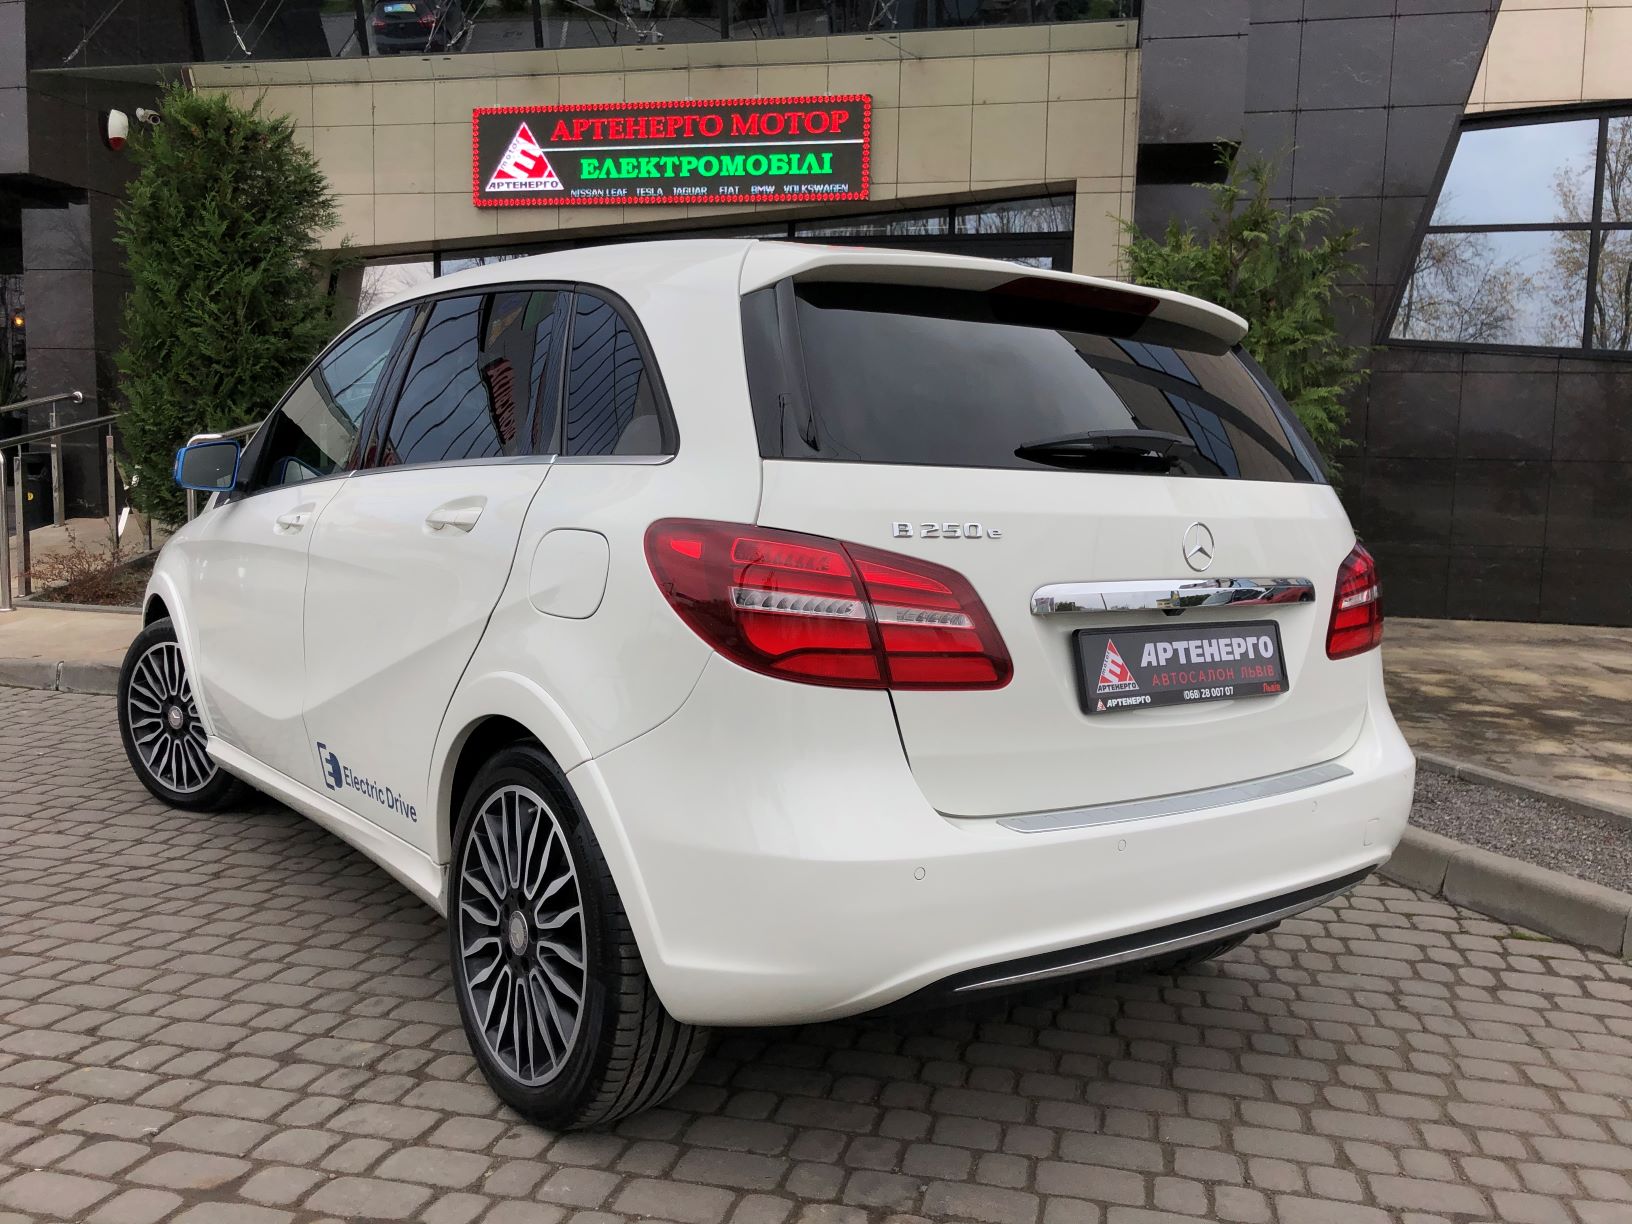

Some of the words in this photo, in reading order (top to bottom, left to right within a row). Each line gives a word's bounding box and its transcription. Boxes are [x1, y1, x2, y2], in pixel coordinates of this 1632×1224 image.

[551, 114, 723, 141] АРТЕНЕРГО
[730, 110, 849, 136] МОТОР
[580, 153, 833, 179] ЕЛЕКТРОМОБІЛІ
[489, 181, 559, 189] АРТЕНЕРГО
[571, 188, 604, 197] NISSAN
[606, 188, 628, 196] LEAF
[636, 187, 663, 196] TESLA
[673, 186, 707, 195] JAGUAR
[719, 186, 739, 194] FIAT
[751, 185, 775, 194] BMW
[892, 521, 914, 538] B
[1141, 636, 1273, 667] АРТЕНЕРГО
[1152, 667, 1234, 687] АВТОСАЛОН
[1241, 665, 1275, 679] ЛЬВІВ
[1098, 683, 1136, 691] АРТЕНЕРГО
[1107, 696, 1151, 707] АРТЕНЕРГО
[343, 765, 385, 805] Electric
[386, 787, 417, 823] Drive
